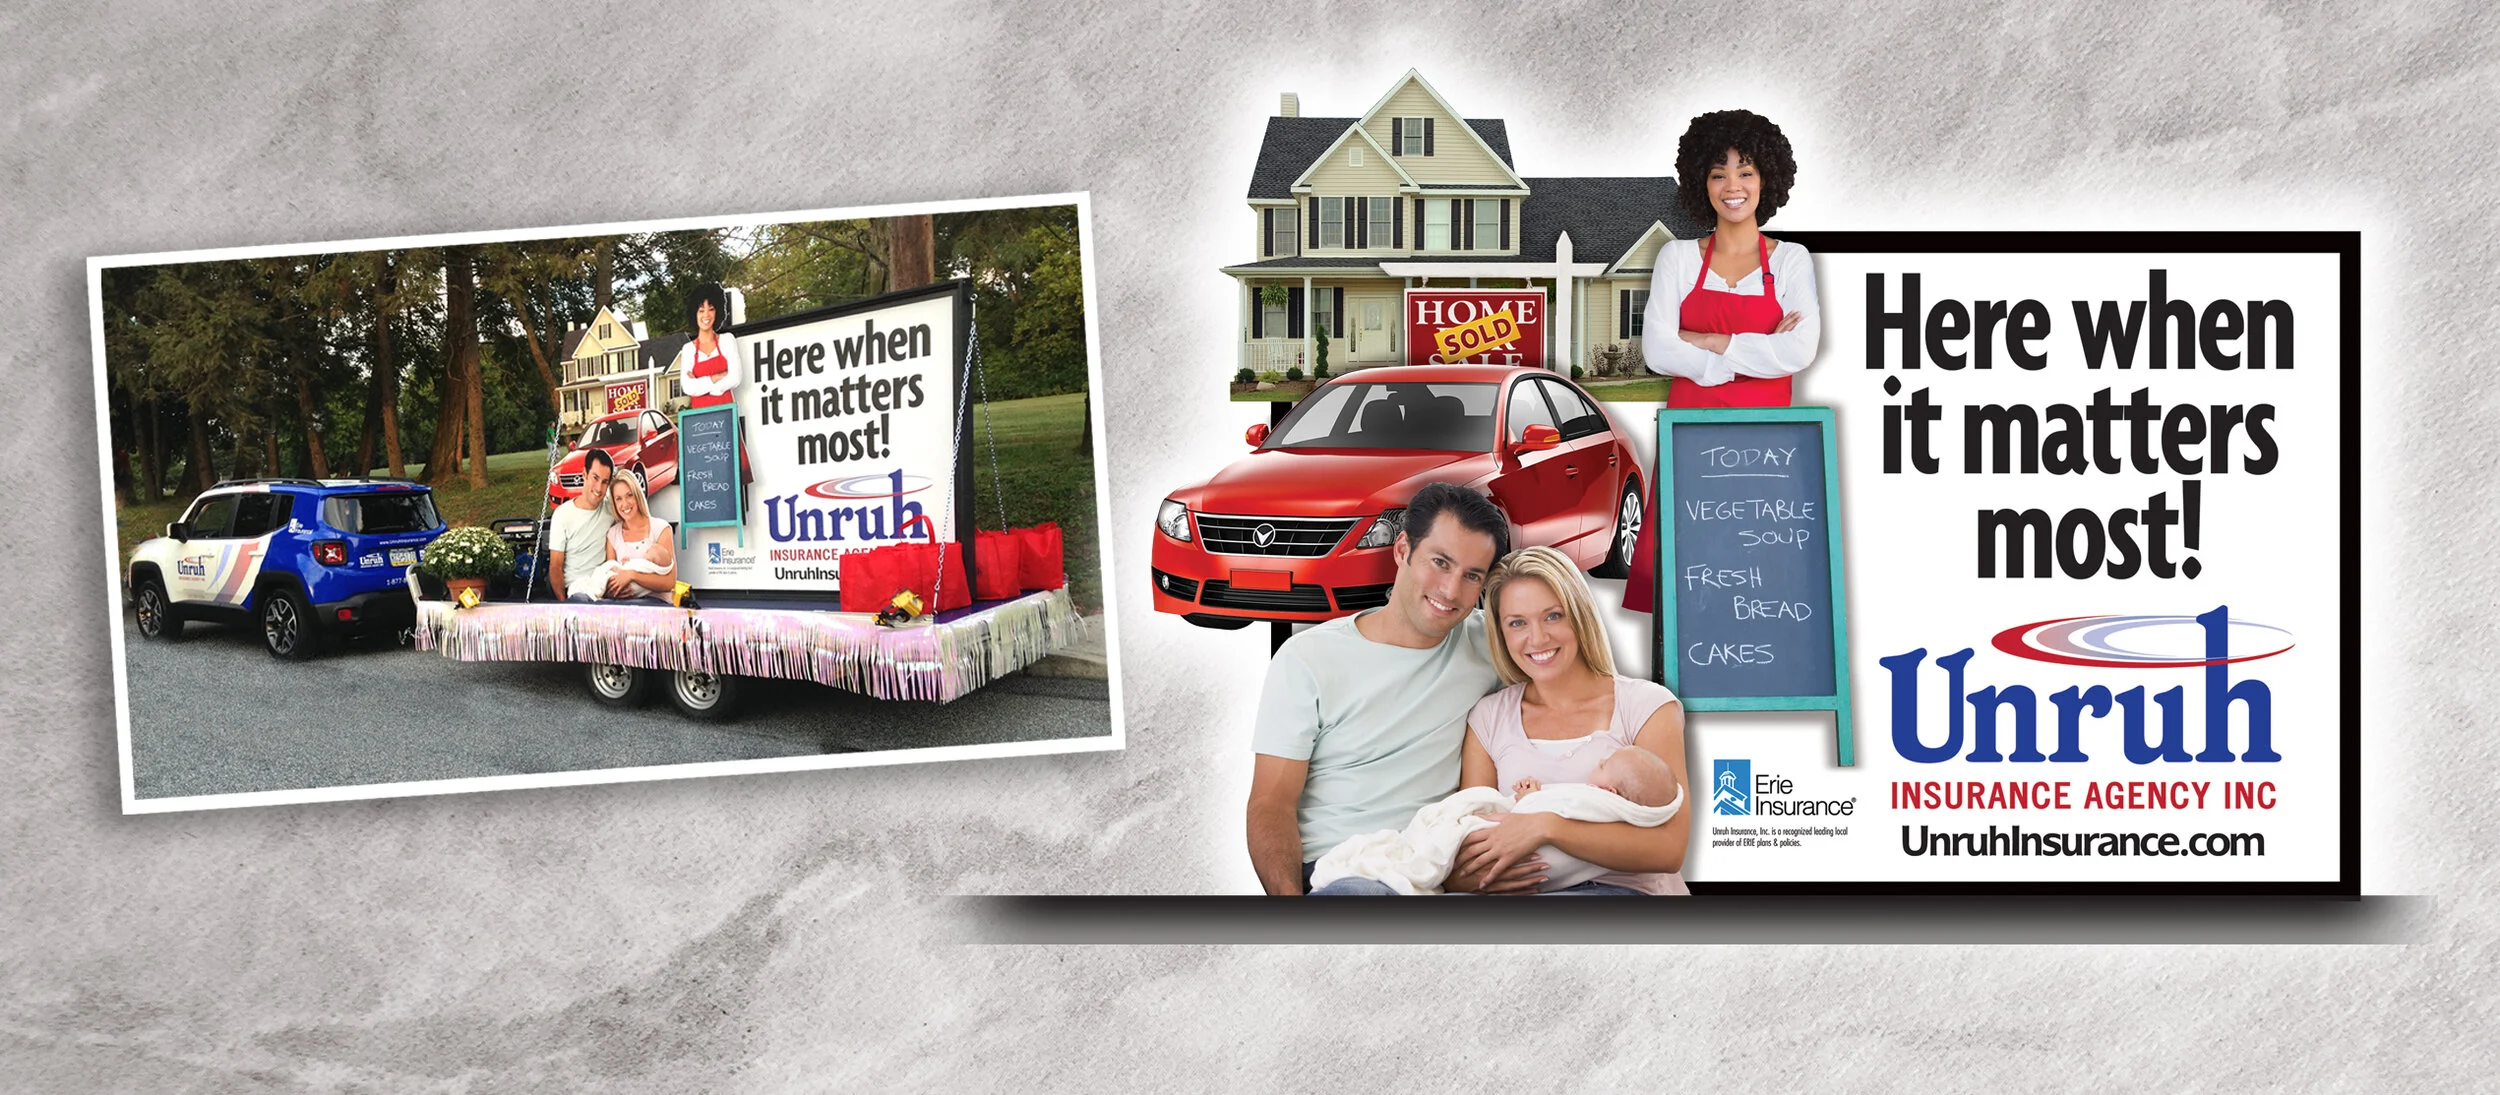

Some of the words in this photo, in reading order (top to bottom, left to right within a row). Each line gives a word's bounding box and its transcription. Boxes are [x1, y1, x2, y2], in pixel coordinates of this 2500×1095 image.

[1415, 300, 1537, 325] HOME
[1866, 272, 2051, 371] Here
[2072, 269, 2294, 371] when
[1444, 318, 1512, 356] SOLD
[754, 339, 825, 383] Here
[833, 319, 931, 370] when
[617, 392, 637, 409] SOLD
[761, 384, 783, 425] it
[792, 374, 924, 421] matters
[692, 420, 724, 432] TODAY
[1883, 375, 1942, 475] it
[1964, 386, 2279, 476] matters
[687, 441, 731, 454] VEGETABLE
[798, 413, 890, 465] most!
[1701, 446, 1796, 468] TODAY
[687, 470, 713, 481] FRESH
[702, 482, 729, 492] BREAD
[688, 500, 717, 511] CAKES
[764, 468, 928, 541] Unruh
[1686, 500, 1815, 522] VEGETABLE
[1738, 528, 1810, 549] SOUP
[1977, 480, 2202, 580] most!
[177, 556, 205, 576] Unruh
[770, 548, 839, 561] INSURANCE
[1685, 564, 1762, 590] FRESH
[1734, 596, 1812, 621] BREAD
[1688, 642, 1774, 665] CAKES
[1879, 605, 2282, 765] Unruh
[1755, 774, 1794, 795] Erie
[1891, 781, 2072, 810] INSURANCE
[2084, 781, 2211, 810] AGENCY
[2224, 781, 2277, 810] INC
[1712, 827, 1730, 836] Unruh
[1731, 827, 1758, 837] Insurance,
[1760, 827, 1770, 836] Inc.
[1772, 827, 1777, 836] is
[1783, 827, 1813, 838] recognized
[1814, 827, 1834, 838] leading
[1835, 827, 1849, 836] local
[1712, 838, 1735, 848] provider
[1736, 838, 1742, 847] of
[1743, 838, 1755, 847] ERIE
[1757, 838, 1772, 848] plans
[1773, 838, 1779, 847] &
[1780, 838, 1802, 848] policies.
[1901, 825, 2265, 857] UnruhInsurance.com
